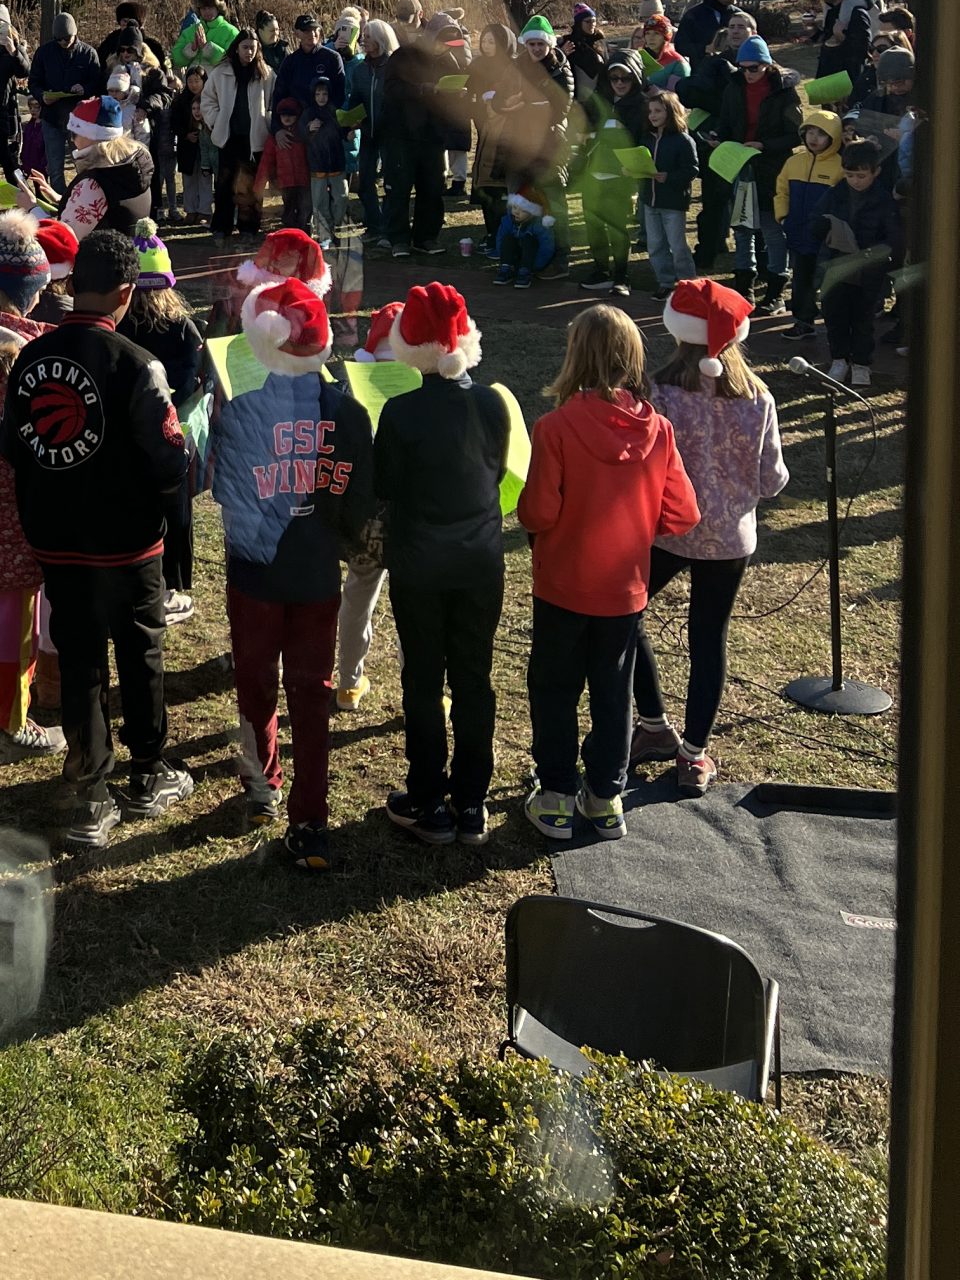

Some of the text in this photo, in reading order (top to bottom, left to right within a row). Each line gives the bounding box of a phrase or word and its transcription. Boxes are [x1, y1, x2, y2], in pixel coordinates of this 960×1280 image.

[18, 362, 97, 405] TORONTO
[20, 422, 98, 465] RAPTORS
[273, 420, 335, 455] GSC
[253, 458, 353, 499] WINGS
